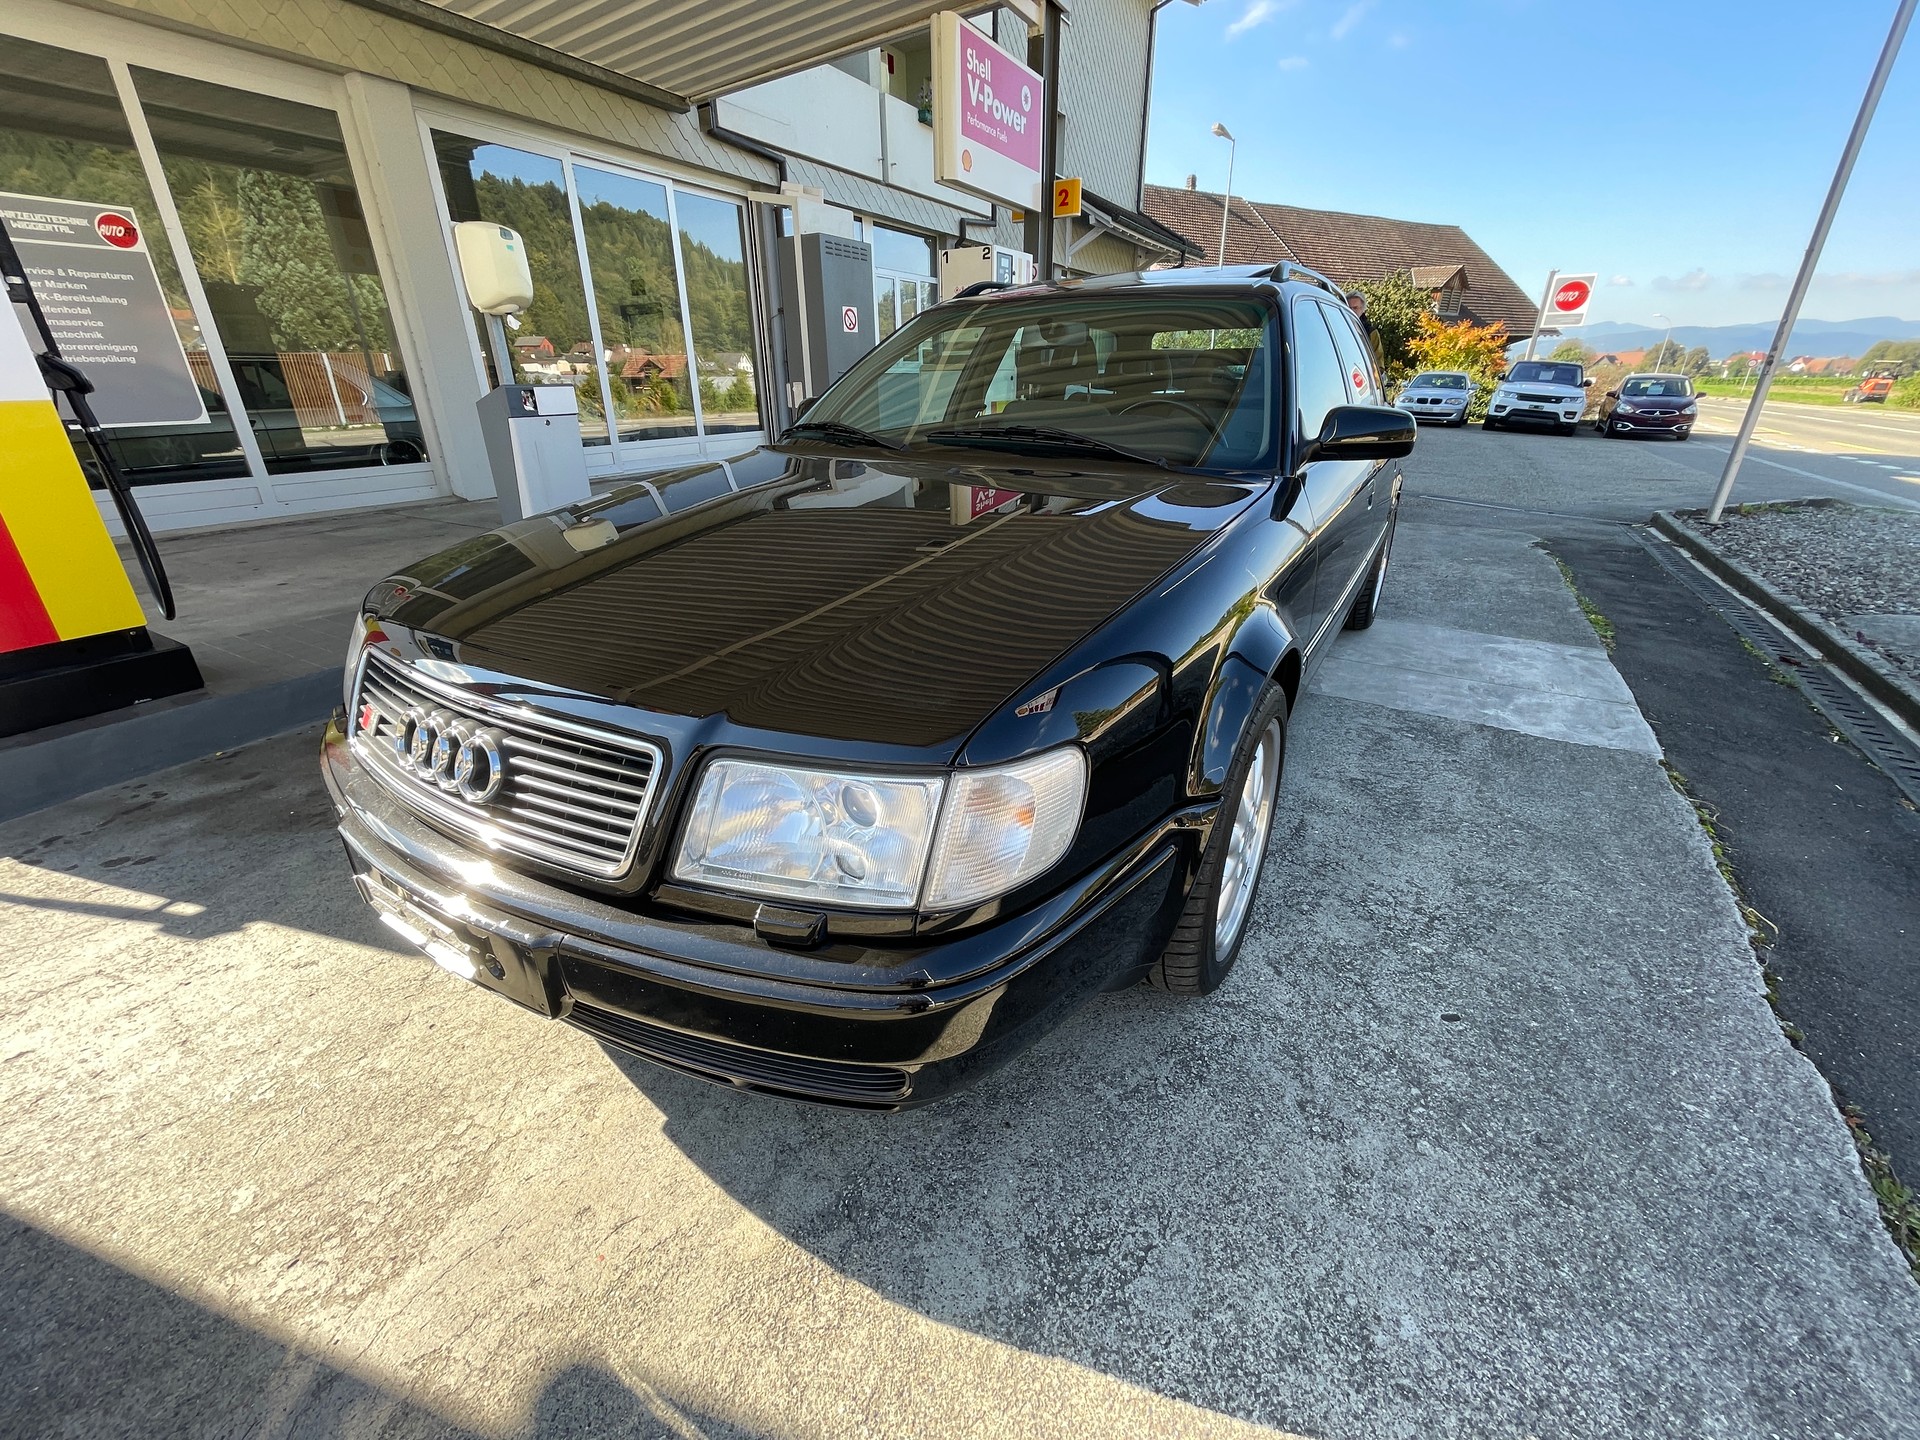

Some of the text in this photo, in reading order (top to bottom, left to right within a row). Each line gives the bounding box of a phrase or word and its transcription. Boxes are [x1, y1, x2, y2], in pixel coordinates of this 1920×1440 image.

[966, 47, 991, 82] Shell
[967, 73, 1027, 135] V-Power
[967, 112, 1008, 143] Performance Fuels
[1058, 188, 1069, 207] 2
[942, 246, 991, 264] 1 2
[24, 267, 134, 281] rvice & Reparaturen
[30, 279, 88, 290] er Marken
[33, 291, 128, 306] FK-Bereitstellung
[41, 304, 92, 315] ifenhotel
[47, 318, 104, 327] maservice
[51, 331, 105, 339] astechnik
[57, 343, 138, 353] otorenreinigung
[63, 354, 136, 364] triebespülung
